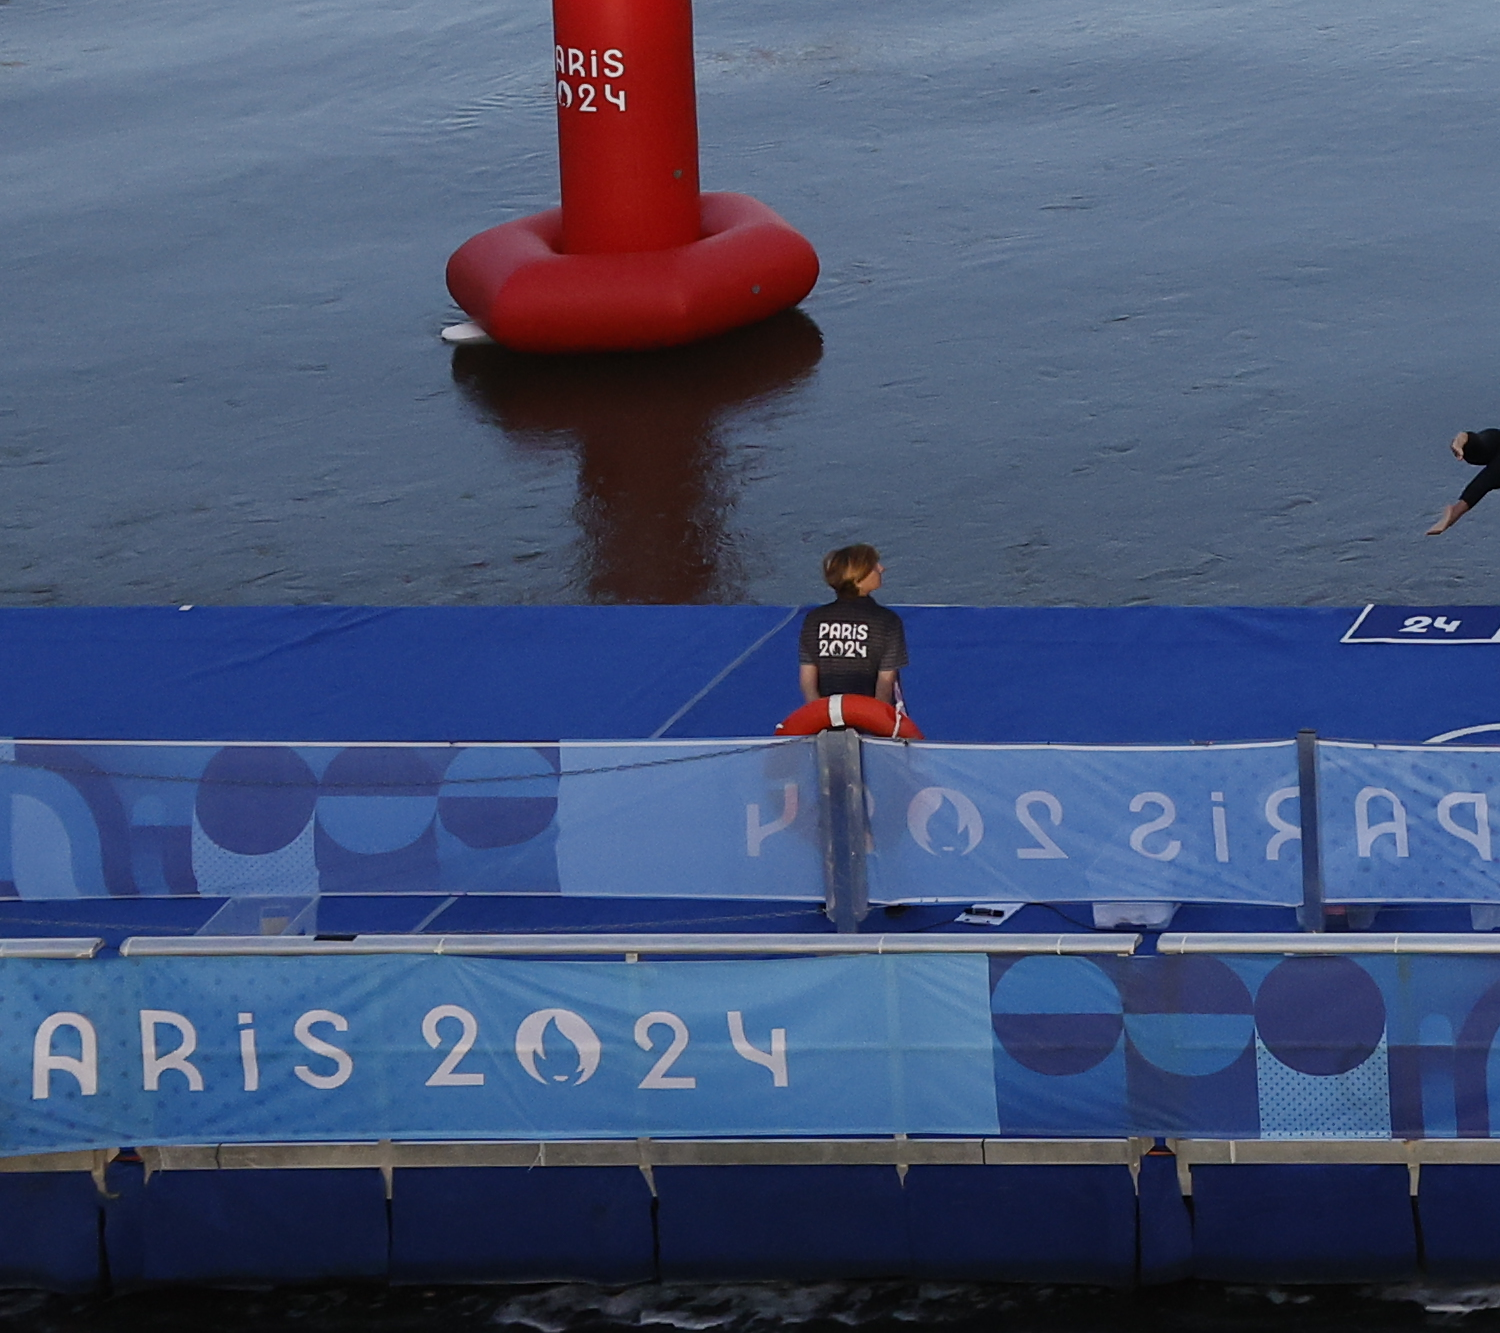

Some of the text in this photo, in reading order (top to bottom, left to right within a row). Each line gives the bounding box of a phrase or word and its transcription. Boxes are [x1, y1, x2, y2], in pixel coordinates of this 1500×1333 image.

[1399, 617, 1462, 633] 24
[819, 640, 867, 658] 2024
[420, 1003, 790, 1090] 2024
